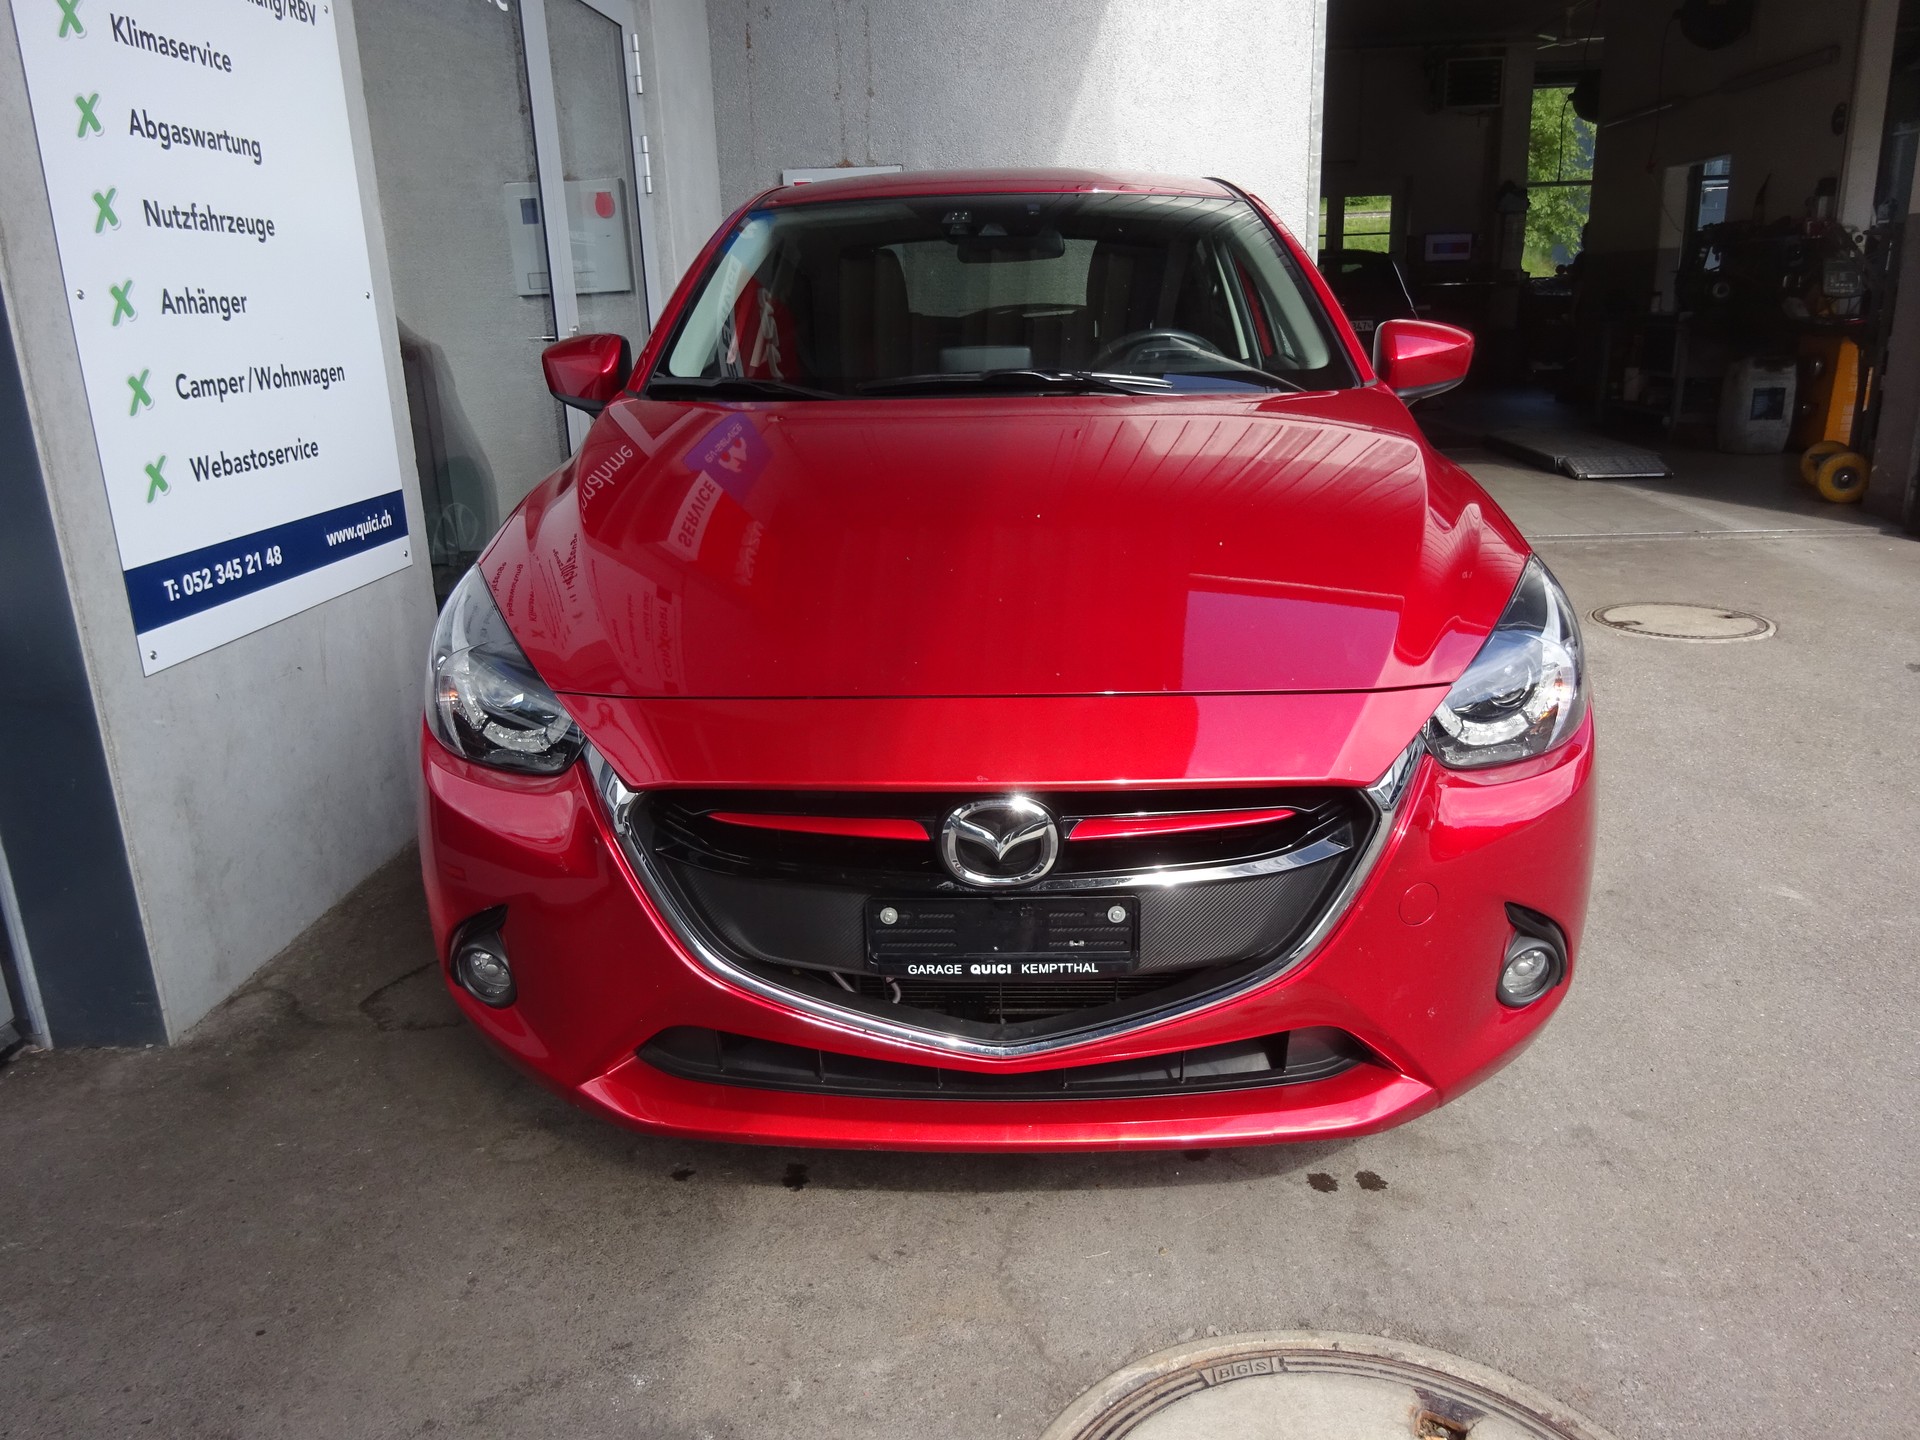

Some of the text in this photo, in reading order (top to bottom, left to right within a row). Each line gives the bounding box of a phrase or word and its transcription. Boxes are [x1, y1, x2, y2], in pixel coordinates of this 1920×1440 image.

[109, 13, 232, 73] Klimaservice
[129, 108, 262, 165] Abgaswartung
[143, 199, 276, 243] Nutzfahrzeuge
[161, 287, 247, 321] Anhänger
[189, 437, 319, 482] Webastoservice
[326, 509, 393, 547] www.quici.ch
[163, 545, 283, 602] T: 052 345 21 48
[907, 962, 1099, 976] GARAGE QUICI KEMPTTHAL
